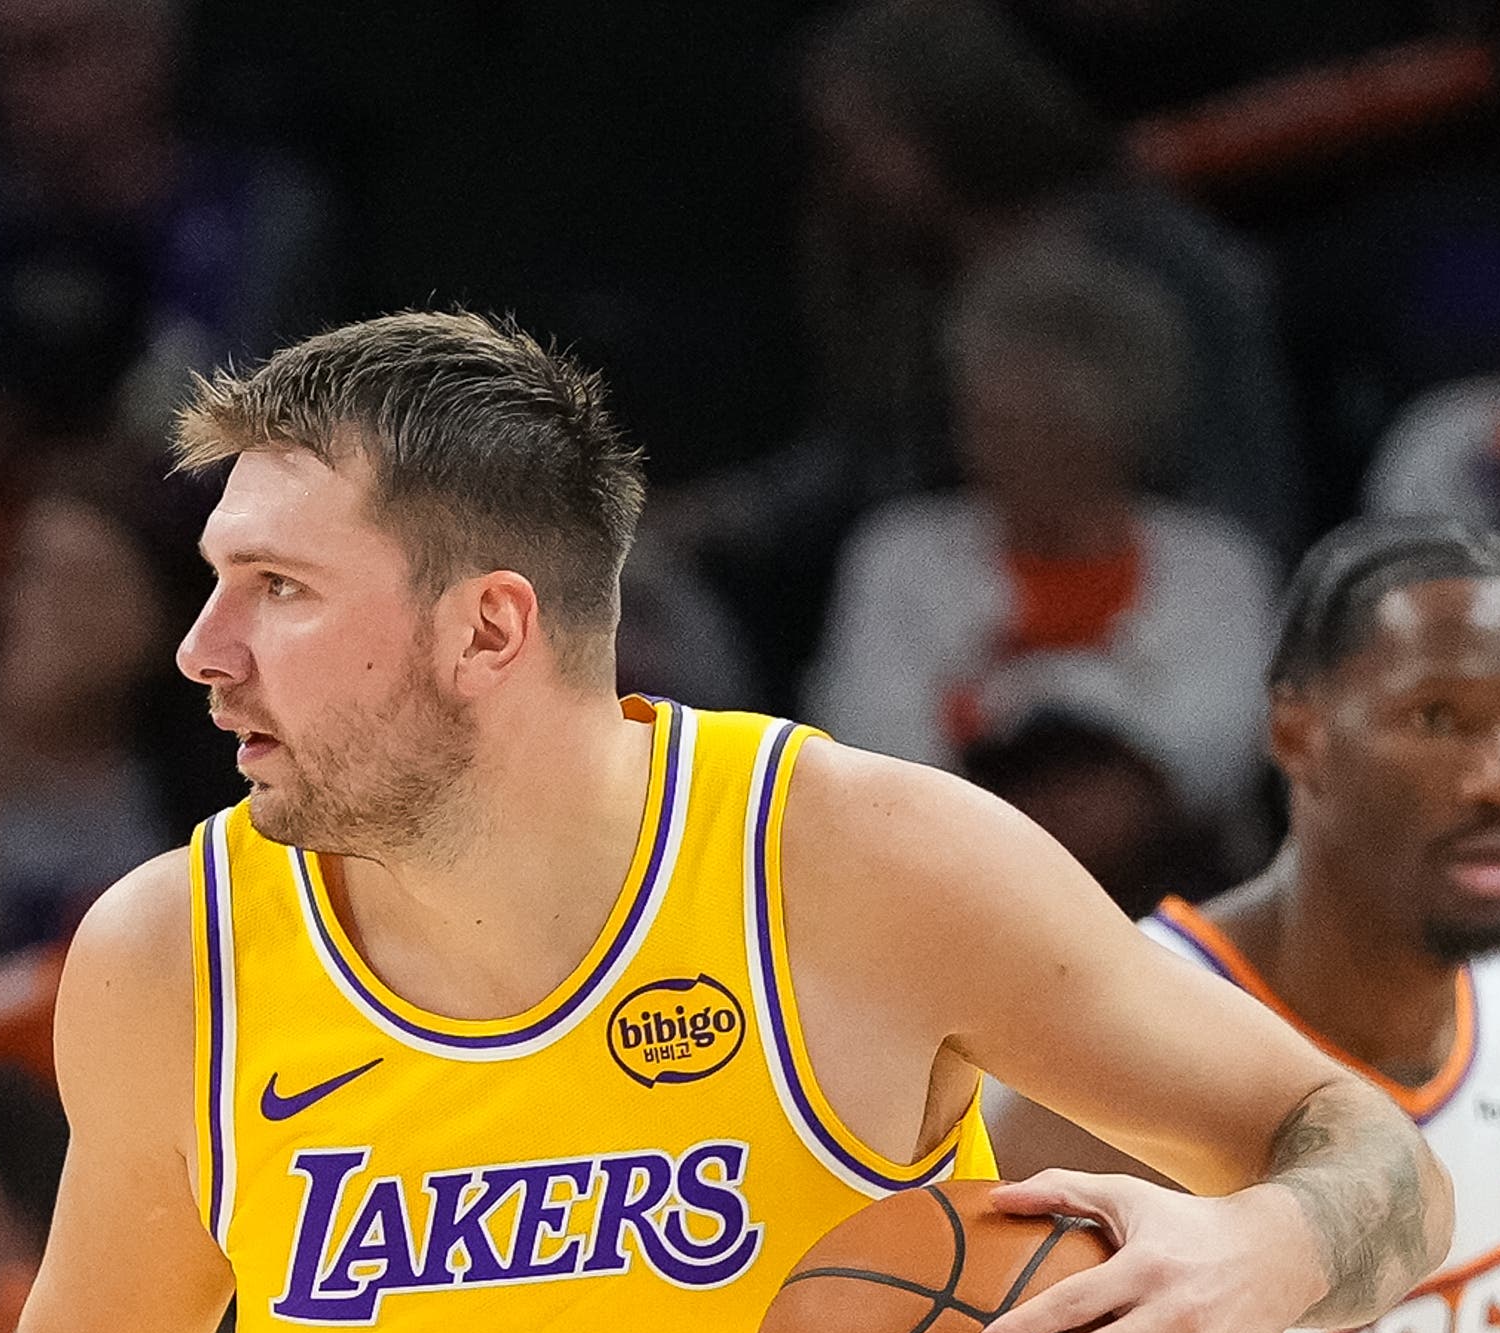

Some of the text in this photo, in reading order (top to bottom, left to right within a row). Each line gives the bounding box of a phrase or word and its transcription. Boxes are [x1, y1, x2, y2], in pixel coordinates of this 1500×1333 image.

[617, 1005, 736, 1049] bibigo
[643, 1042, 692, 1064] 비비고
[270, 1138, 765, 1327] LAKERS
